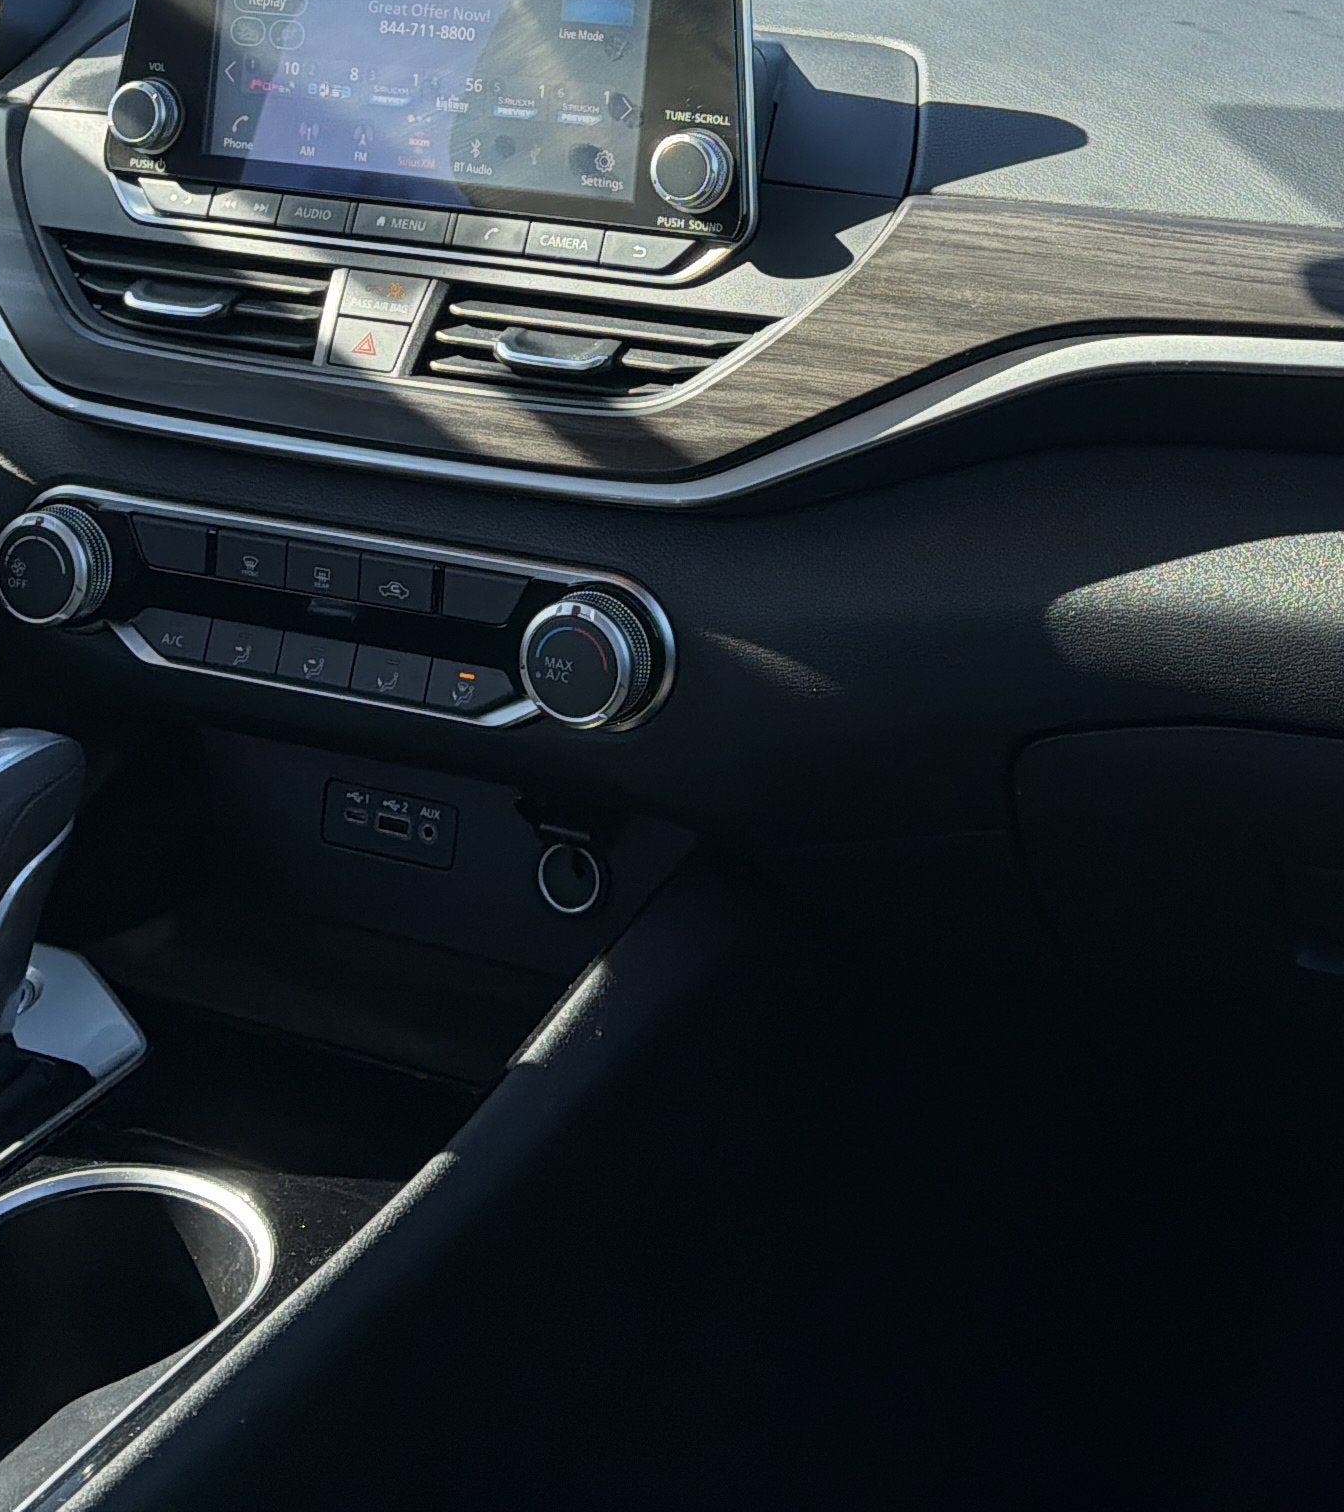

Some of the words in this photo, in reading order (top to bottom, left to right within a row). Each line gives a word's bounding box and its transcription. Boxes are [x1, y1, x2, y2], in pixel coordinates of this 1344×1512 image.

[368, 0, 408, 16] Great
[411, 3, 450, 19] Offer
[453, 7, 491, 23] Now!
[379, 20, 476, 41] 844-711-8800
[559, 28, 576, 40] Live
[578, 29, 604, 42] Mode
[149, 62, 166, 72] VOL
[284, 61, 300, 75] 10
[350, 67, 359, 81] 8
[413, 74, 419, 87] 1
[465, 77, 483, 92] 56
[538, 84, 546, 99] 1
[603, 90, 611, 104] 1
[223, 137, 254, 151] Phone
[299, 146, 315, 157] AM
[354, 152, 367, 162] FM
[129, 157, 154, 169] PUSH
[454, 162, 465, 174] BT
[466, 163, 493, 176] Audio
[581, 175, 624, 191] Settings
[294, 206, 332, 221] AUDIO
[391, 217, 427, 232] MENU
[657, 215, 684, 229] PUSH
[688, 219, 724, 233] SOUND
[539, 234, 588, 251] CAMERA
[350, 297, 373, 309] PASS
[7, 576, 29, 590] OFF
[161, 632, 184, 648] A/C
[544, 656, 573, 672] MAX
[546, 669, 569, 684] A/C
[401, 801, 409, 813] 2
[419, 806, 441, 820] AUX
